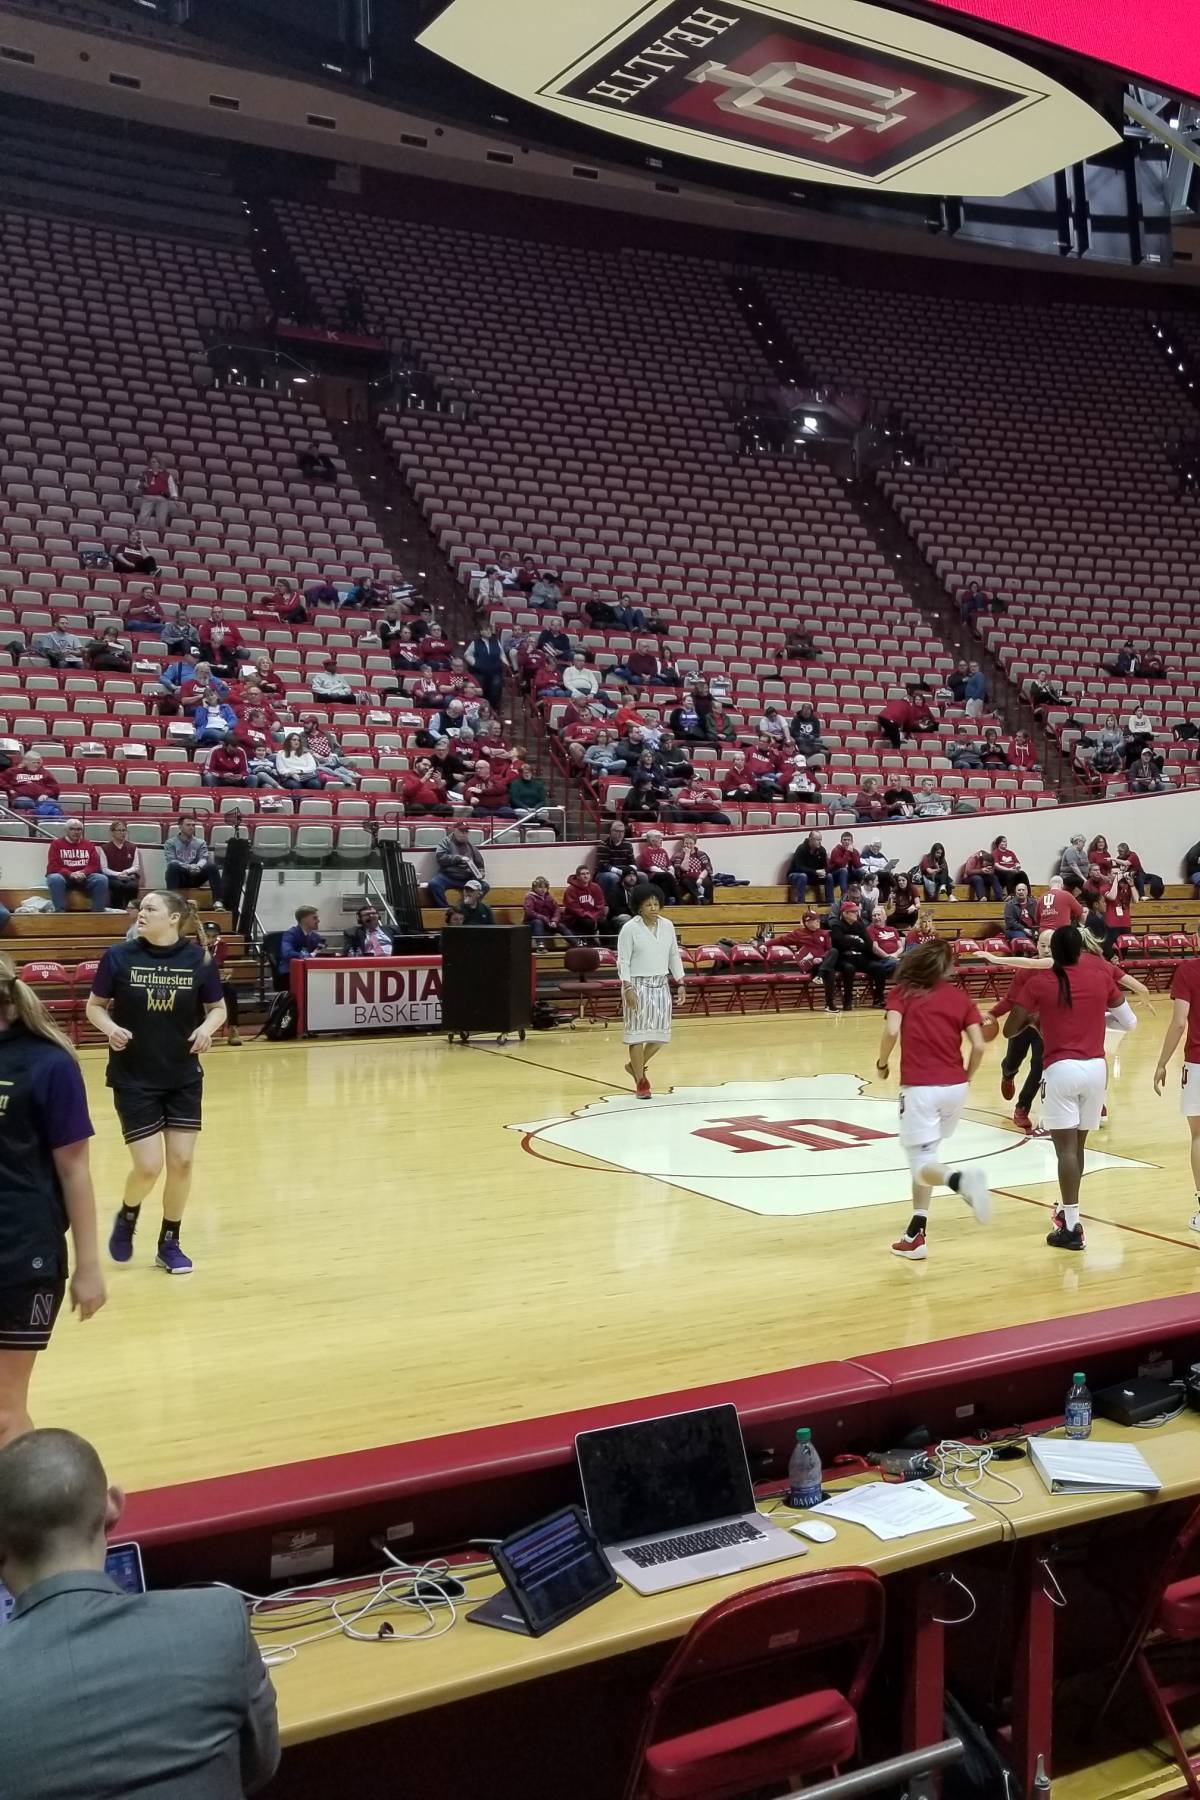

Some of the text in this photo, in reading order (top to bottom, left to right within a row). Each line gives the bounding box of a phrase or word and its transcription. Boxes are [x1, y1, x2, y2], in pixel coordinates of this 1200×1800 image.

[587, 7, 740, 103] HEALTH
[130, 970, 193, 986] Northwestern
[30, 1294, 54, 1325] N
